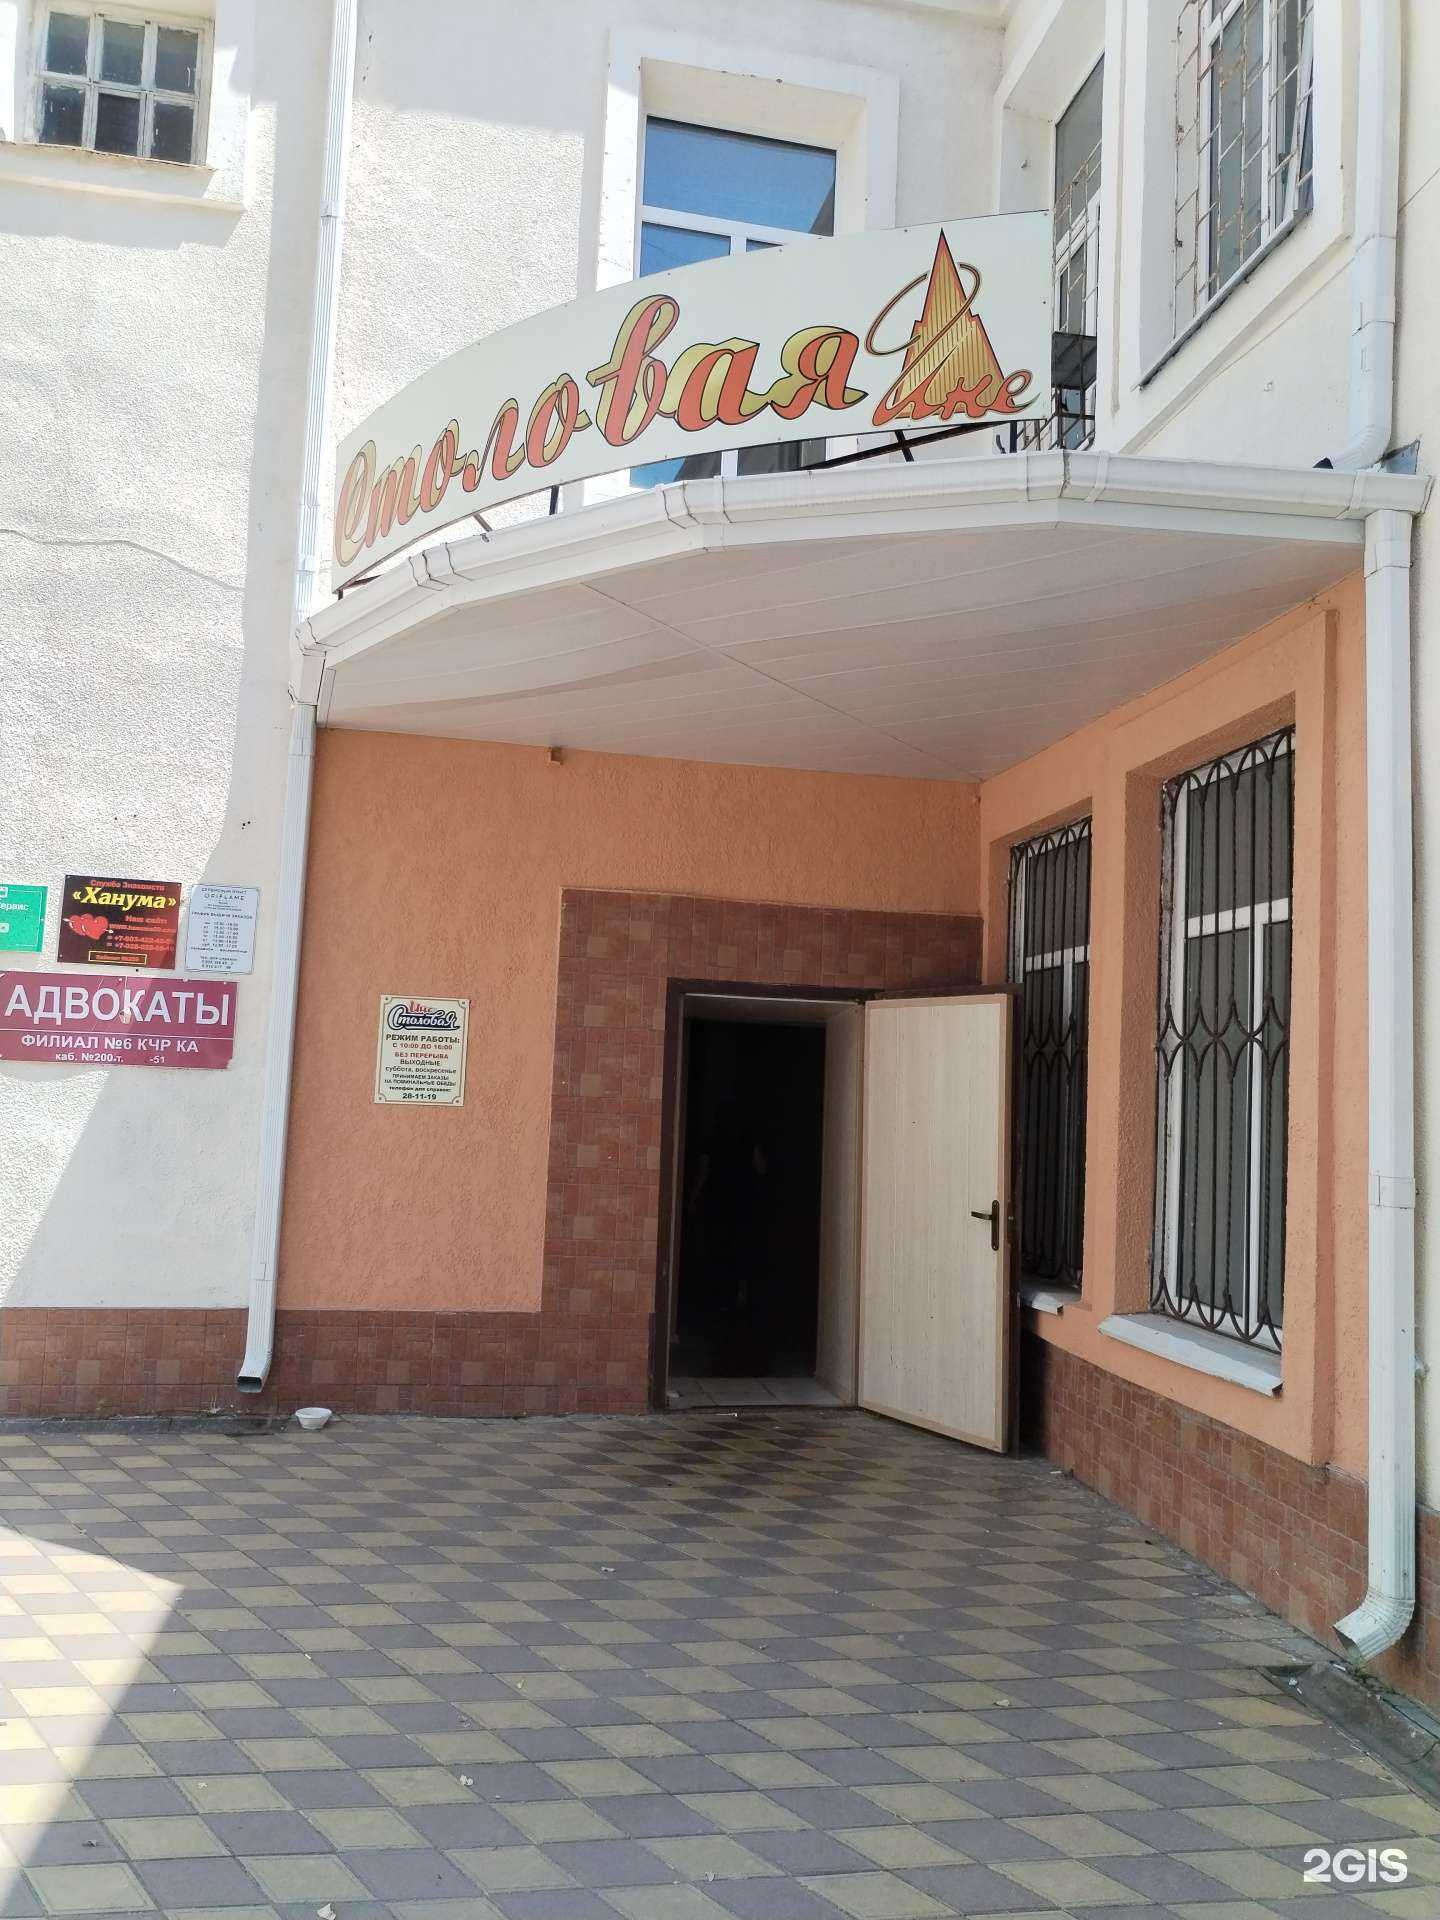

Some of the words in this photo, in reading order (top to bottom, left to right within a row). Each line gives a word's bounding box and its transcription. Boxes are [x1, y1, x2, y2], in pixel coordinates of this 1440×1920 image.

[336, 294, 867, 567] Столовая
[73, 887, 176, 911] «Ханума»
[4, 984, 229, 1025] АДВОКАТЫ
[388, 1004, 460, 1030] Столовая
[21, 1034, 98, 1049] ФИЛИАЛ
[104, 1038, 132, 1050] №6
[138, 1040, 171, 1051] КЧР
[177, 1041, 199, 1052] КА
[55, 1053, 78, 1061] каб.
